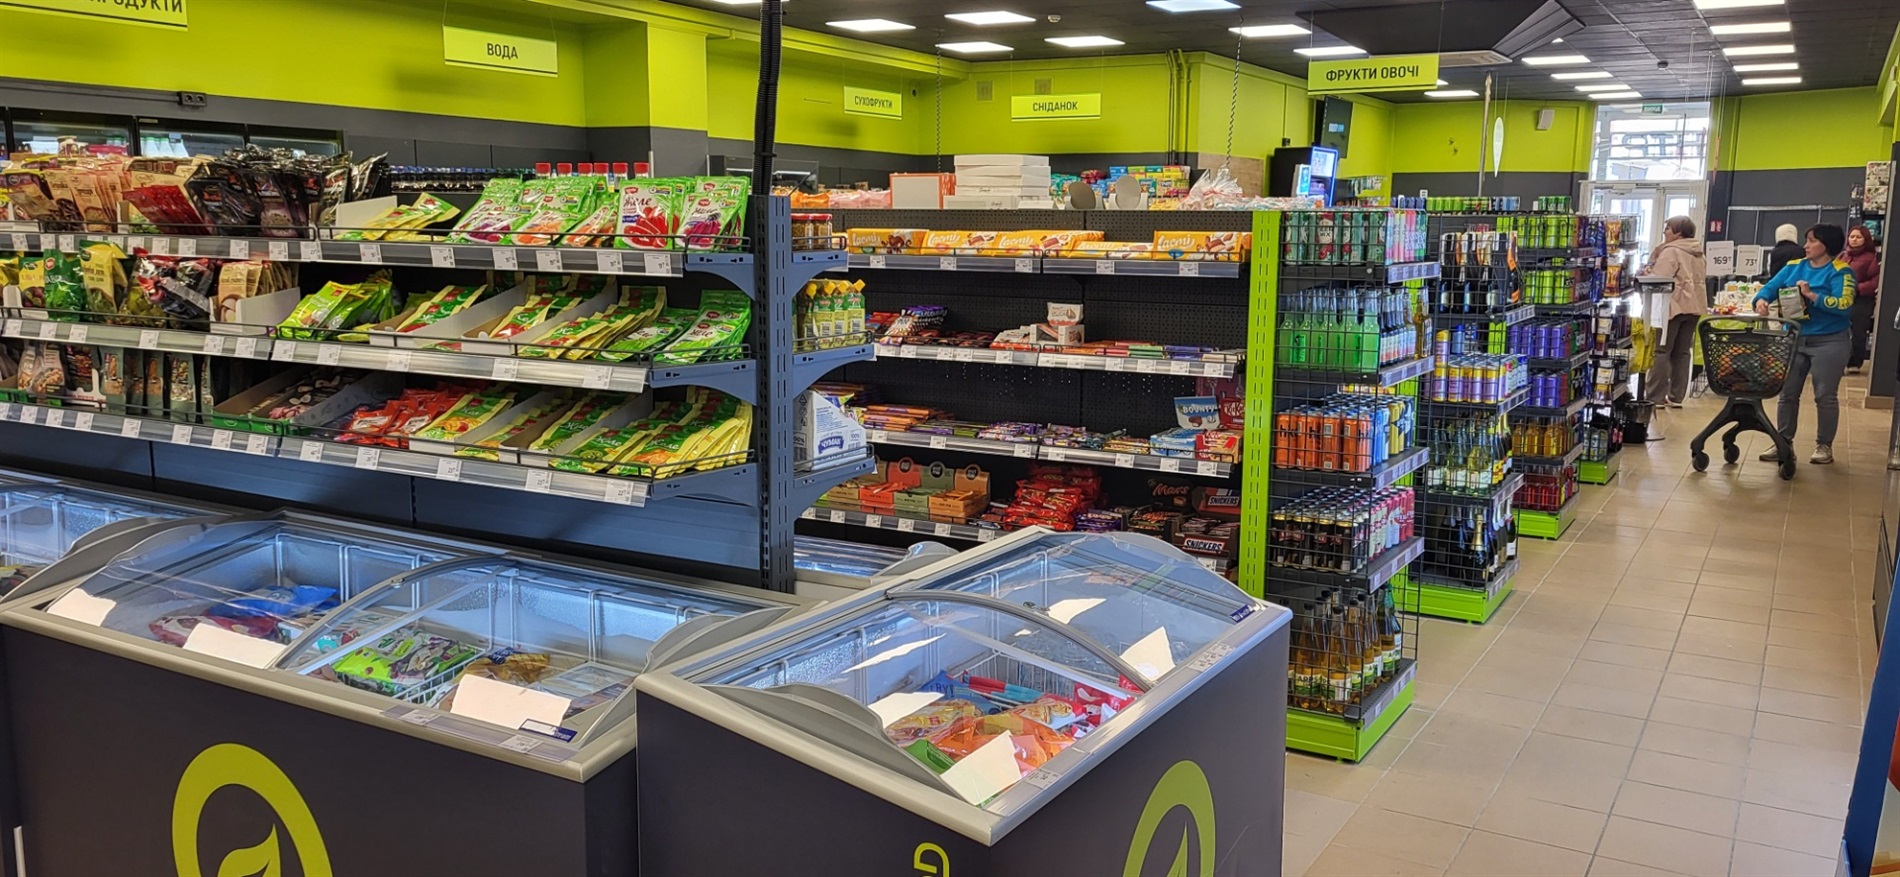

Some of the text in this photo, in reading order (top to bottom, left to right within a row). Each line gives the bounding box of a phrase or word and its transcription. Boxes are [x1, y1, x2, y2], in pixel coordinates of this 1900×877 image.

[487, 43, 518, 60] ВОДА
[1326, 65, 1419, 82] ФРУКТИ ОВОЧІ
[854, 95, 893, 108] СУХОФРУКТИ
[1032, 101, 1078, 112] СНІДАНОК
[1713, 256, 1728, 265] 169
[1182, 404, 1215, 414] BOUNTY
[646, 438, 680, 450] Желе
[821, 436, 841, 448] ЧУМАК
[1152, 483, 1190, 497] Mars
[1209, 497, 1239, 505] SNICKERS
[1186, 540, 1222, 550] SNICKERS
